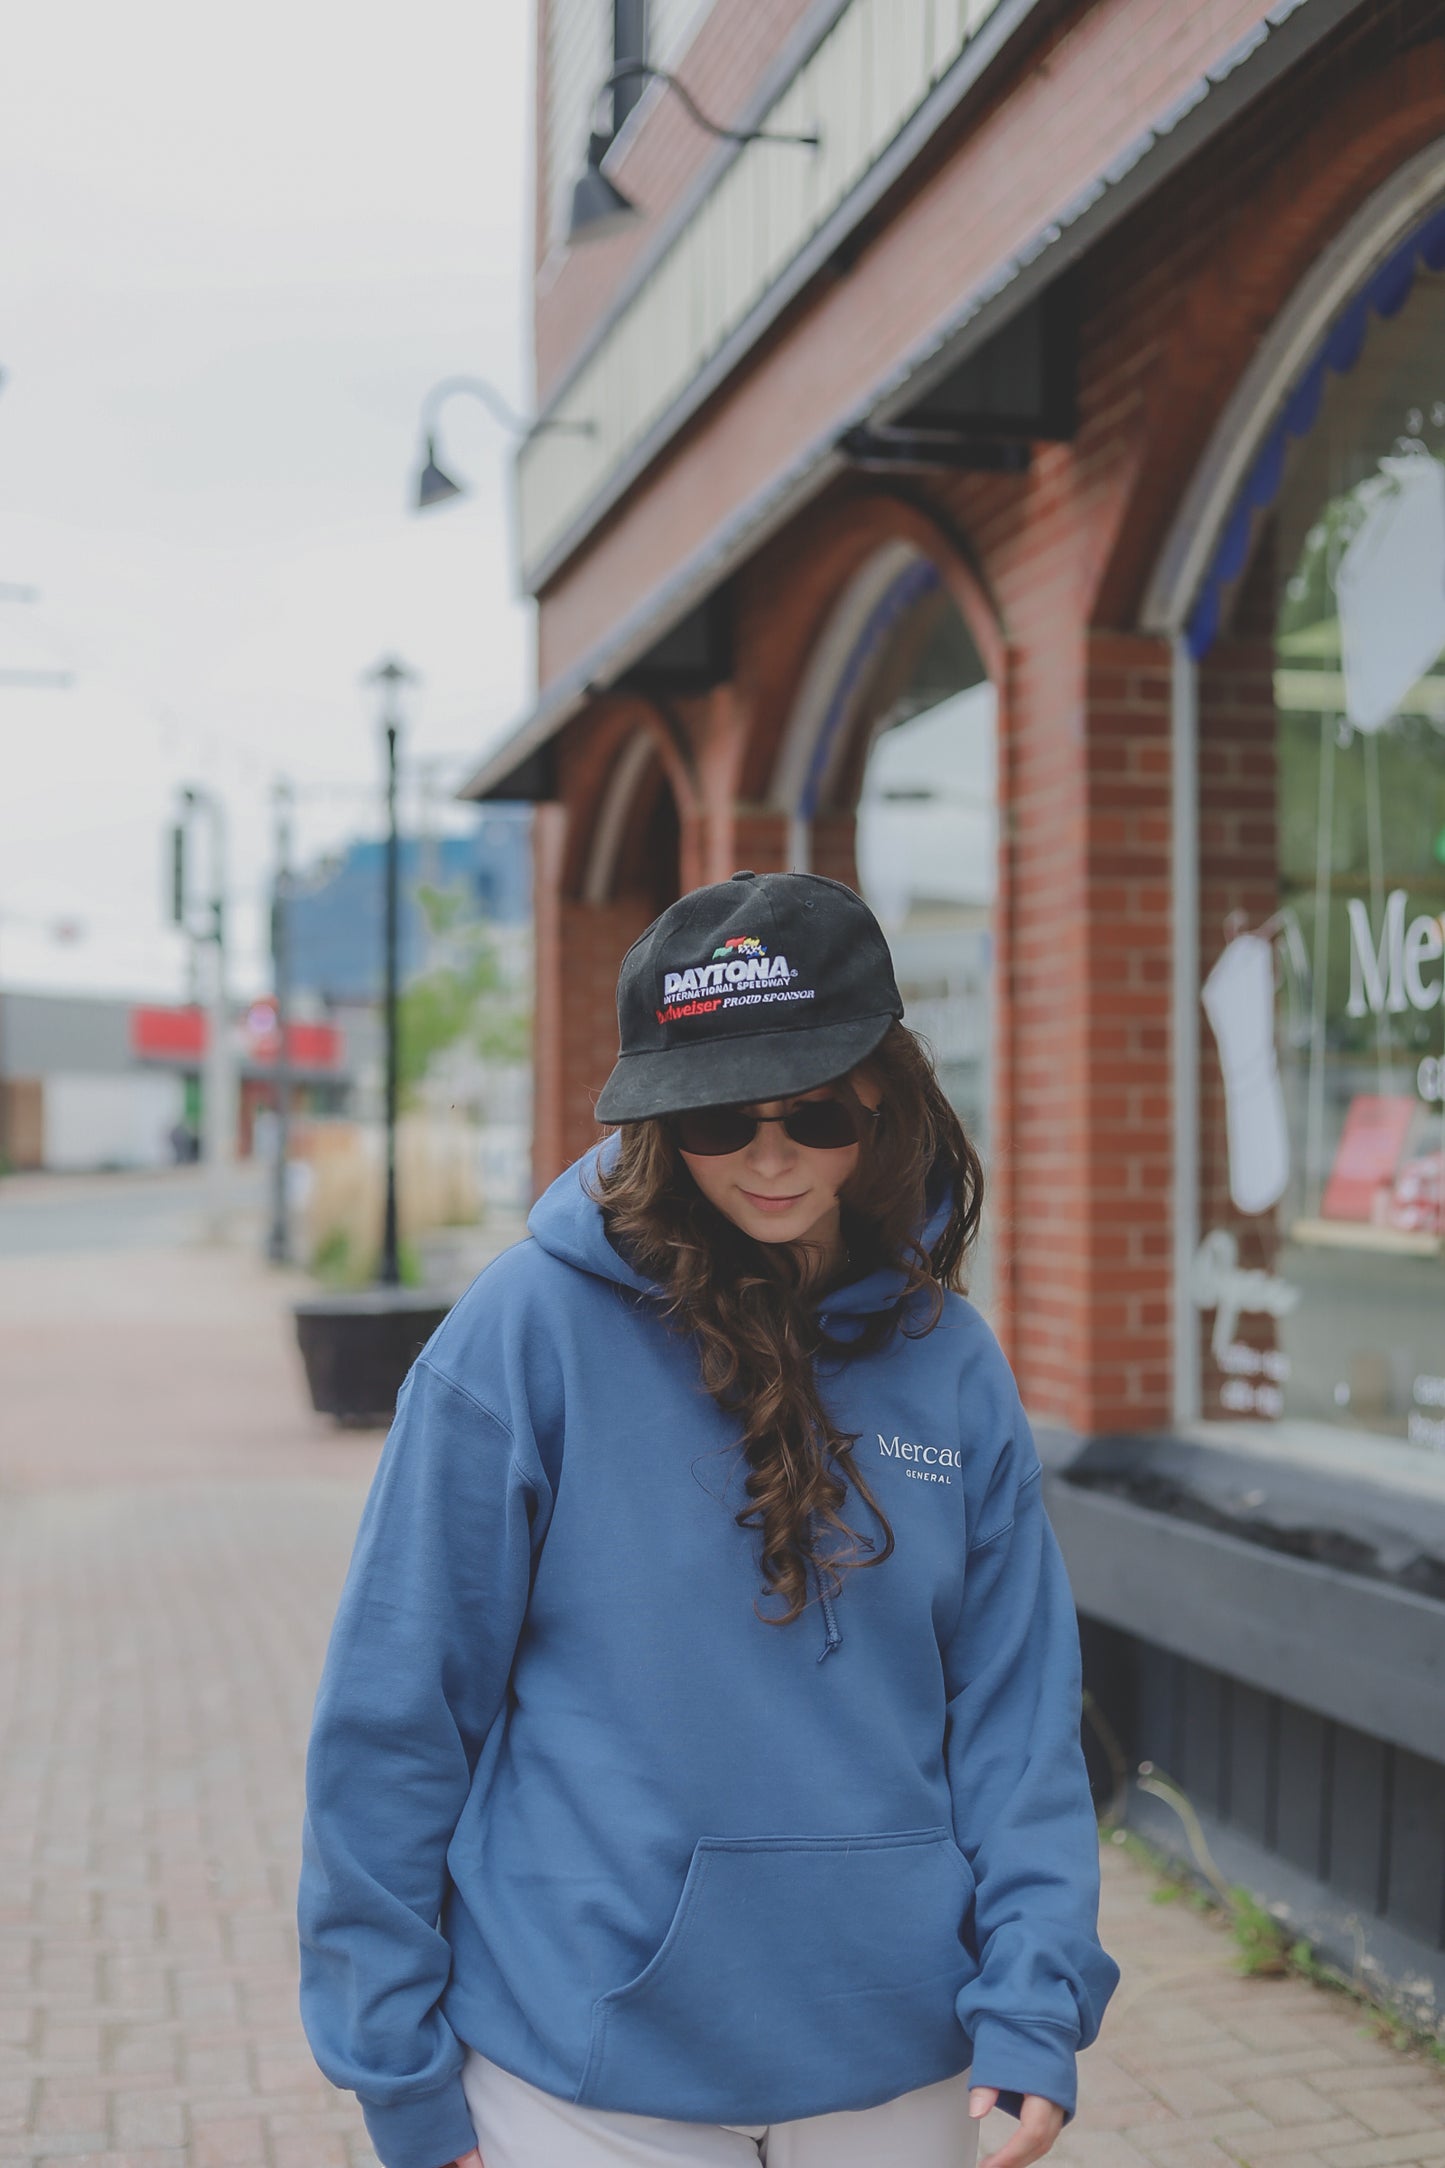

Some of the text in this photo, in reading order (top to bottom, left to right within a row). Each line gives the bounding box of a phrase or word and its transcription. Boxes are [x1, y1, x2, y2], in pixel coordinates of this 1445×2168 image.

[1346, 889, 1445, 1018] Me
[664, 955, 790, 996] DAYTONA
[736, 976, 791, 992] SPEEDWAY
[722, 994, 762, 1009] PROUD
[762, 989, 815, 1003] SPONSOR
[905, 1469, 952, 1484] GENERAL
